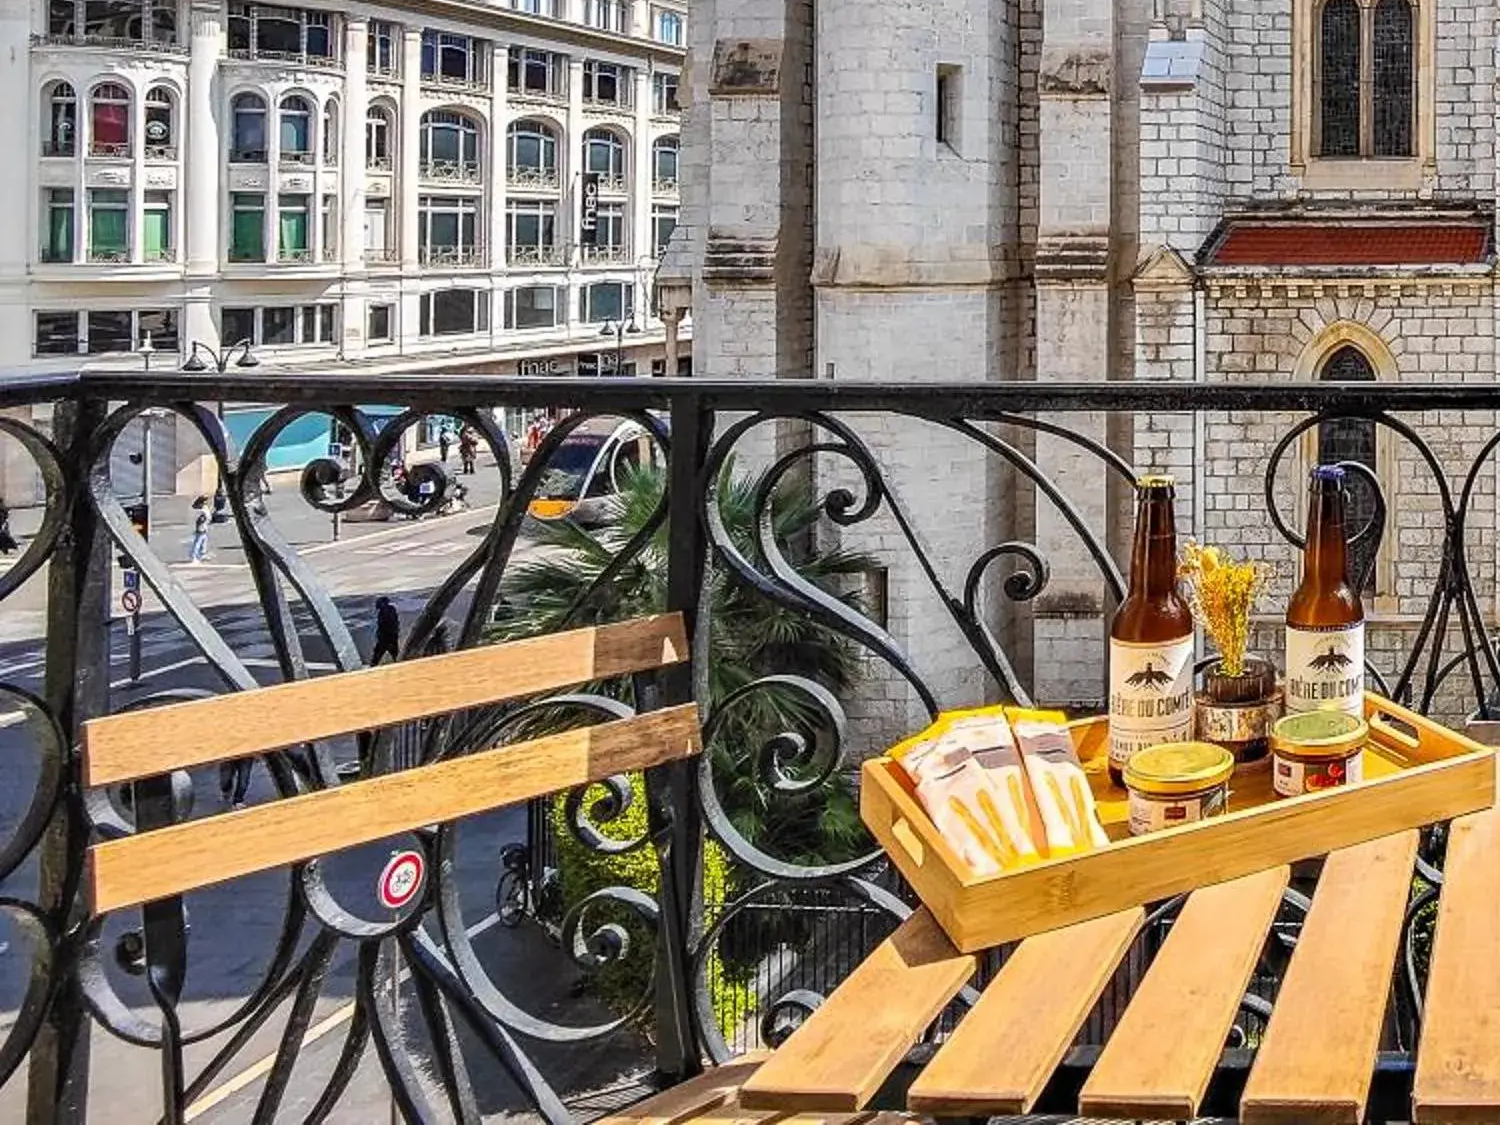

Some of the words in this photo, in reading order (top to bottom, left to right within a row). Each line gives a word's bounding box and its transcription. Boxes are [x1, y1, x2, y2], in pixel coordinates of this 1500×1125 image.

[582, 182, 597, 230] fnac
[519, 359, 558, 376] fnac
[1321, 681, 1337, 700] DU
[1338, 675, 1361, 698] COM
[1137, 699, 1155, 718] DU
